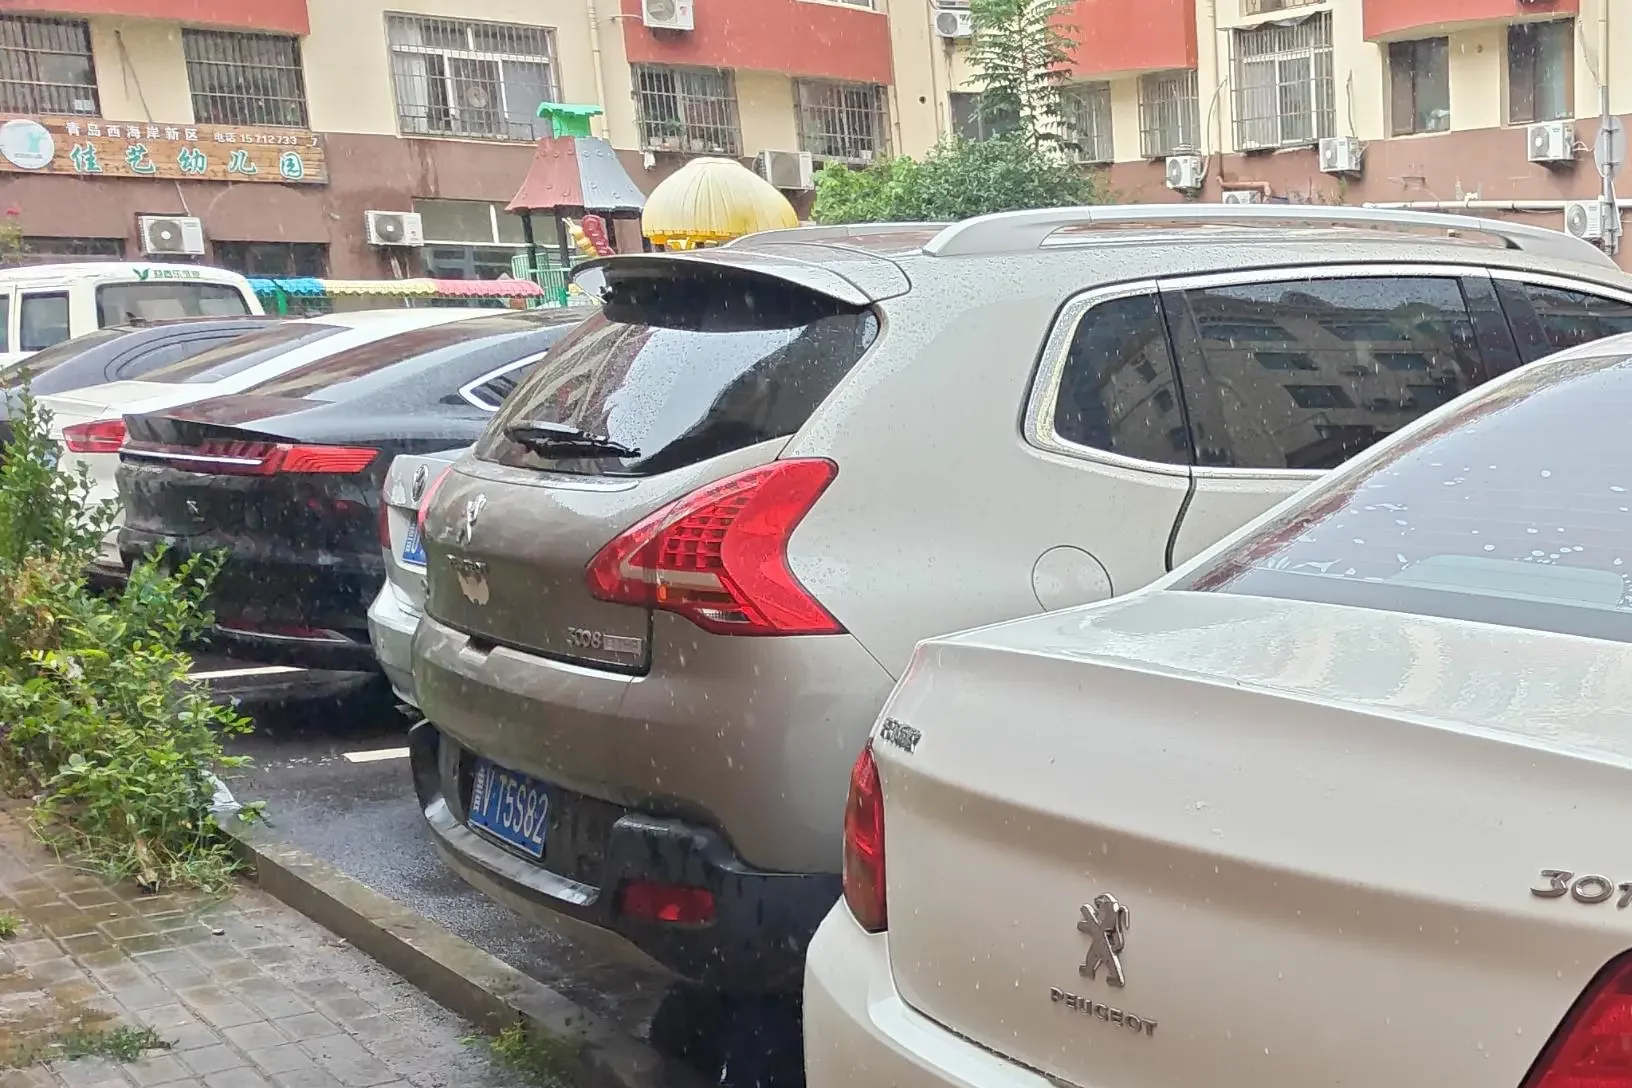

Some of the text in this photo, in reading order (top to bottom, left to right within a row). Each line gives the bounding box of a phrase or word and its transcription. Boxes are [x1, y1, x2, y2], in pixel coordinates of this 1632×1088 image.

[66, 121, 199, 141] 青岛西海岸新区
[214, 131, 236, 143] 电话
[70, 140, 304, 180] 佳艺幼儿园
[1050, 985, 1158, 1038] PEUGEOT
